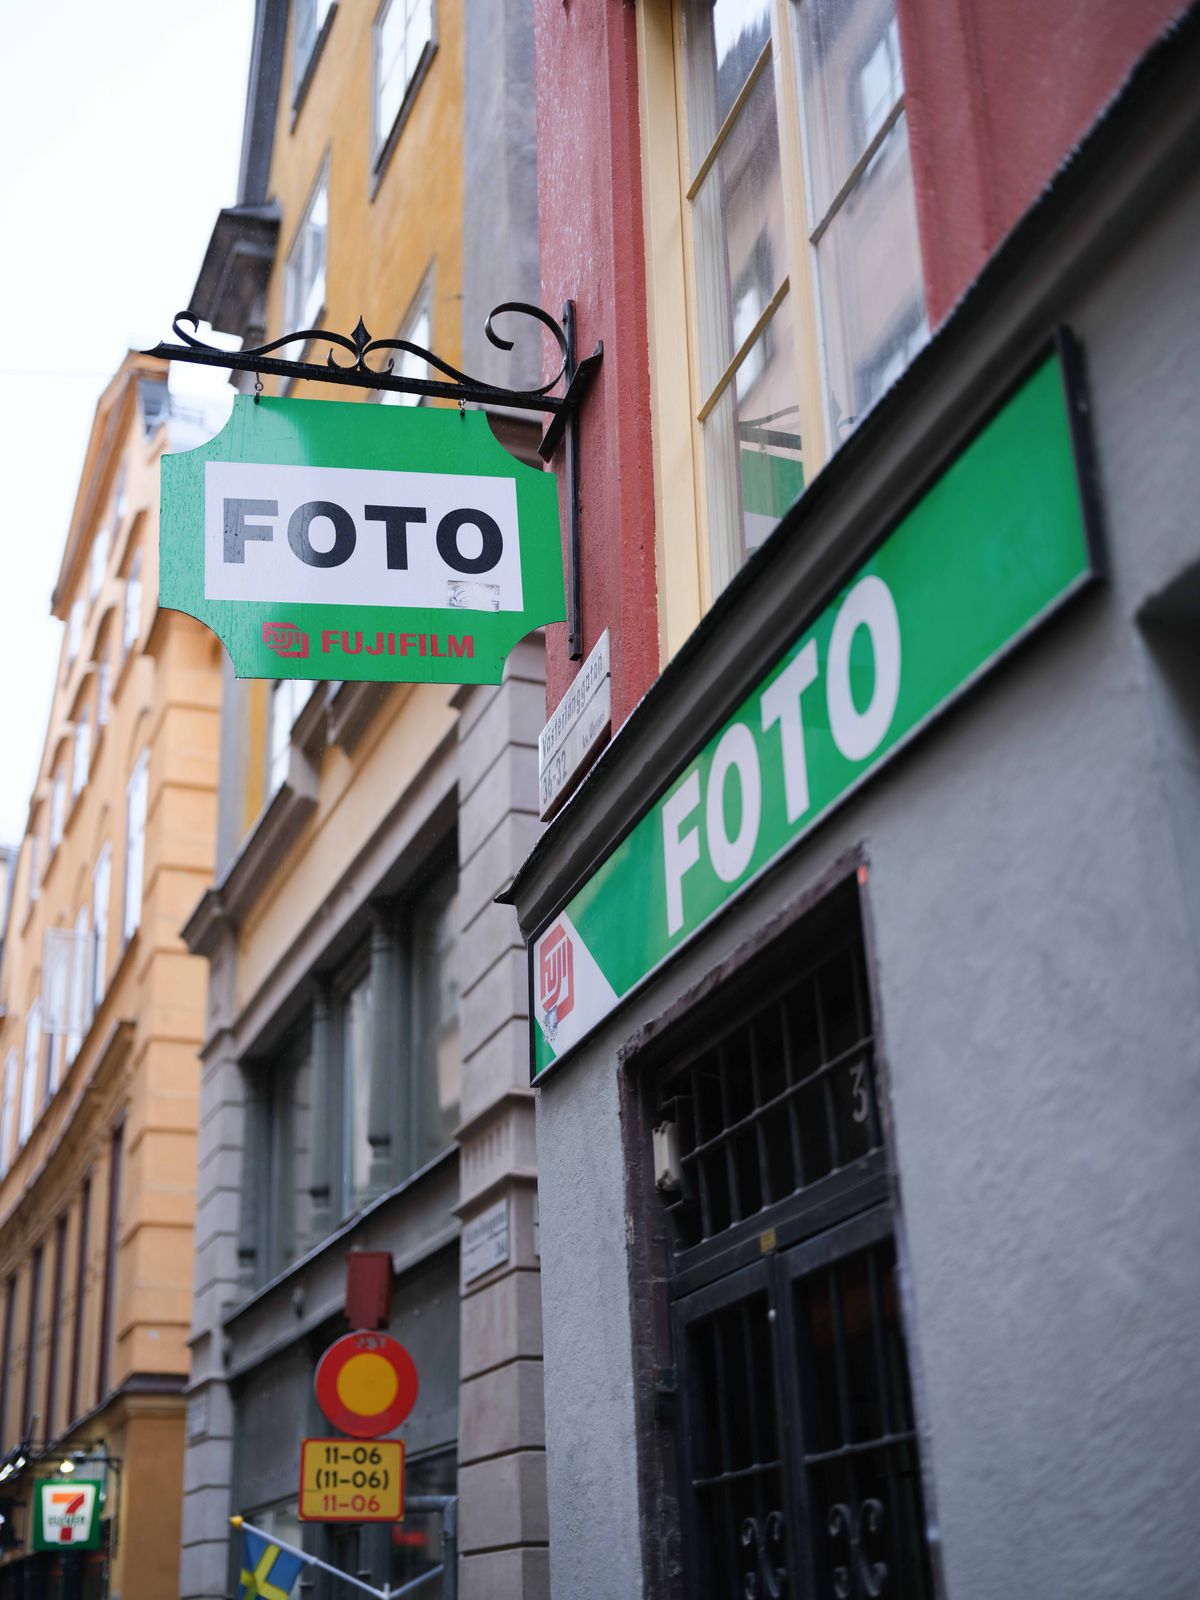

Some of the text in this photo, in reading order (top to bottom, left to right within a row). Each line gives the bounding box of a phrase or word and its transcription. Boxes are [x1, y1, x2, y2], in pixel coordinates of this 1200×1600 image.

[223, 498, 504, 575] FOTO
[321, 630, 474, 659] FUJIFILM
[661, 575, 901, 938] FOTO
[850, 1060, 869, 1122] 3
[325, 1447, 382, 1465] 11-06
[315, 1468, 389, 1490] (11-06)
[322, 1494, 381, 1512] 11-06
